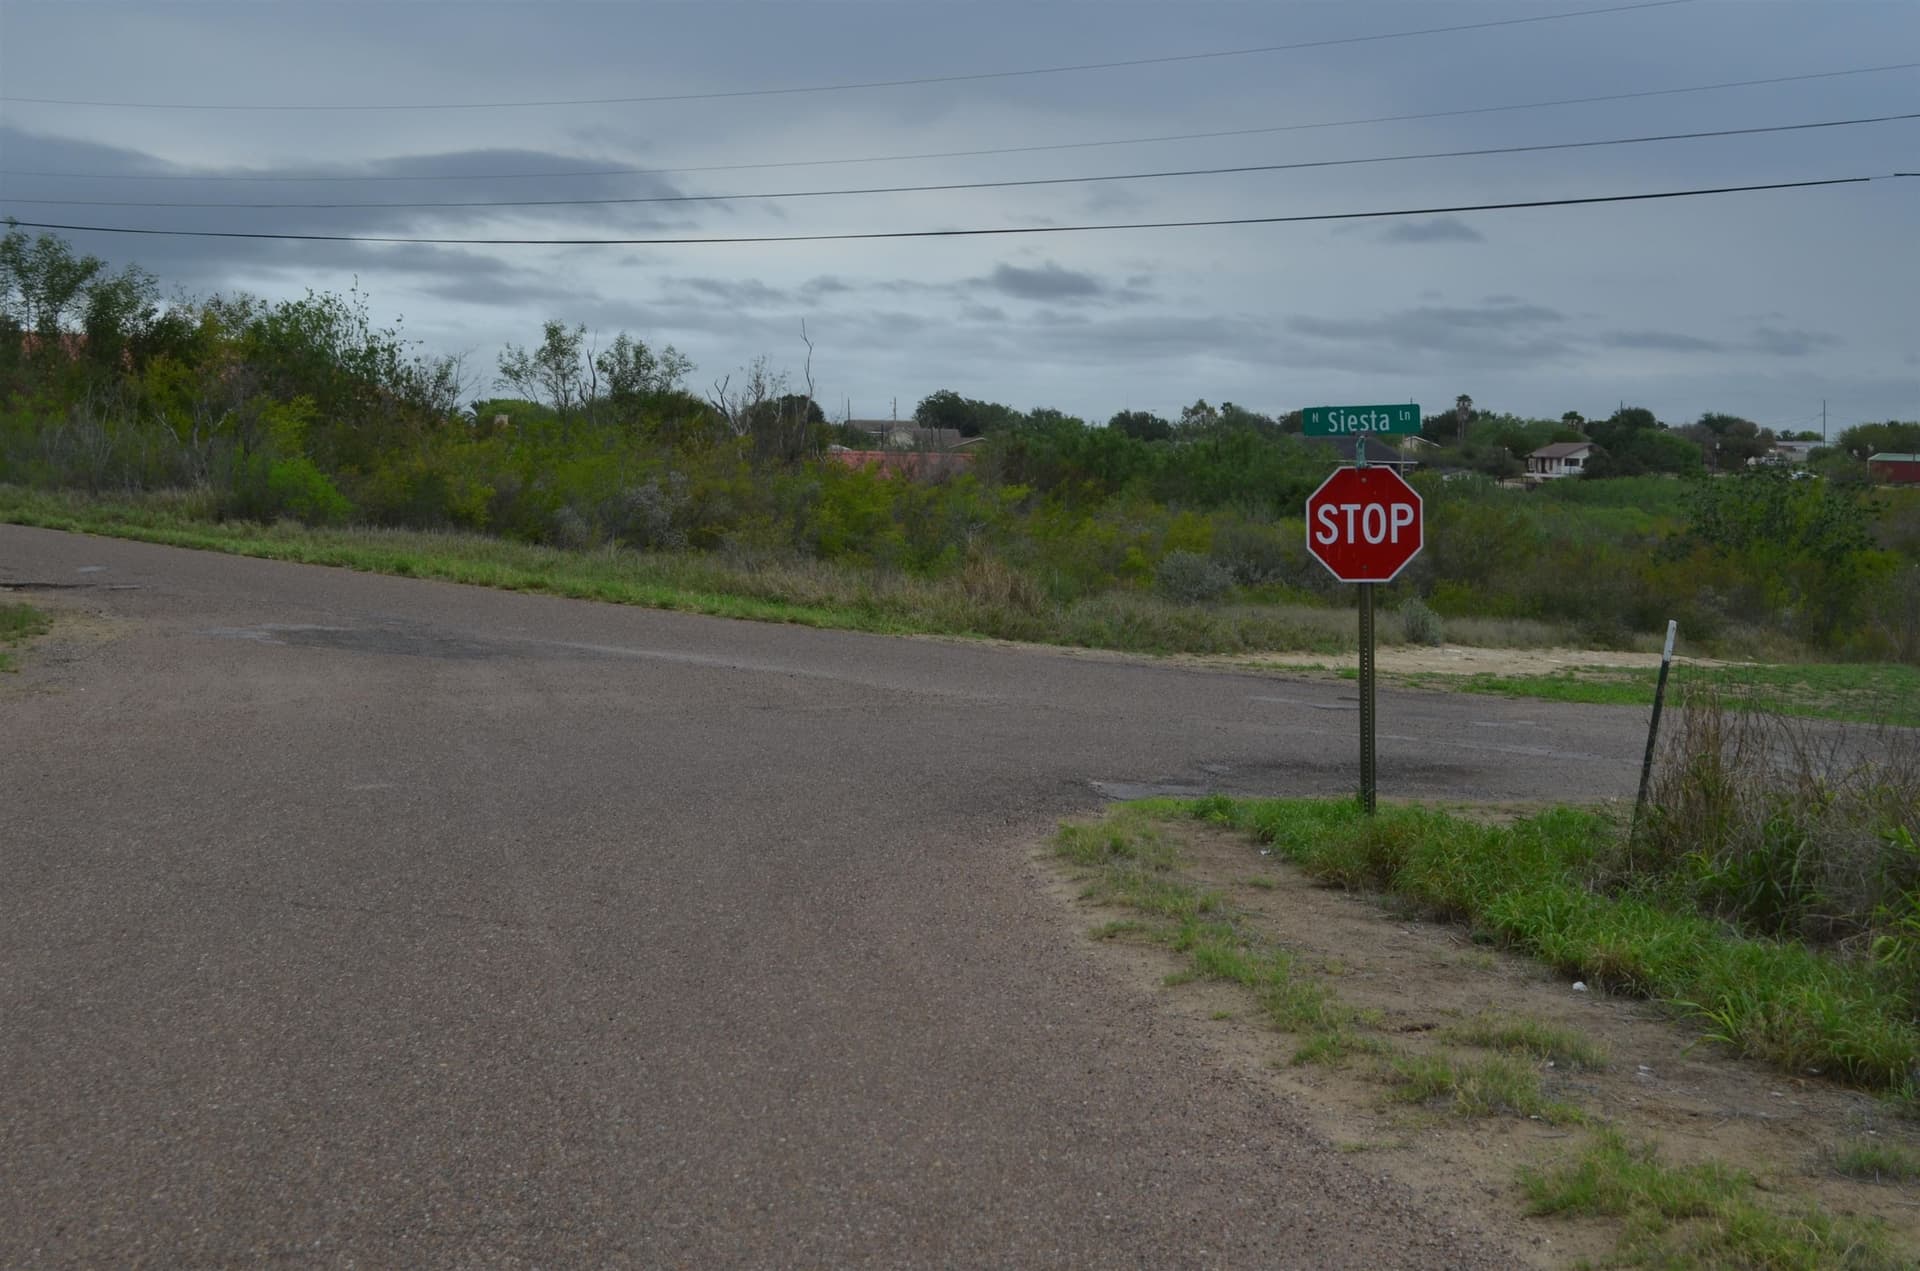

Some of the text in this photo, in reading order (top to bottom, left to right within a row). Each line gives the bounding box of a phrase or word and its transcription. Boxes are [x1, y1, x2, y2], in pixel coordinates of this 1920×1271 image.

[1312, 410, 1411, 432] N Siesta Ln
[1316, 503, 1414, 544] STOP
